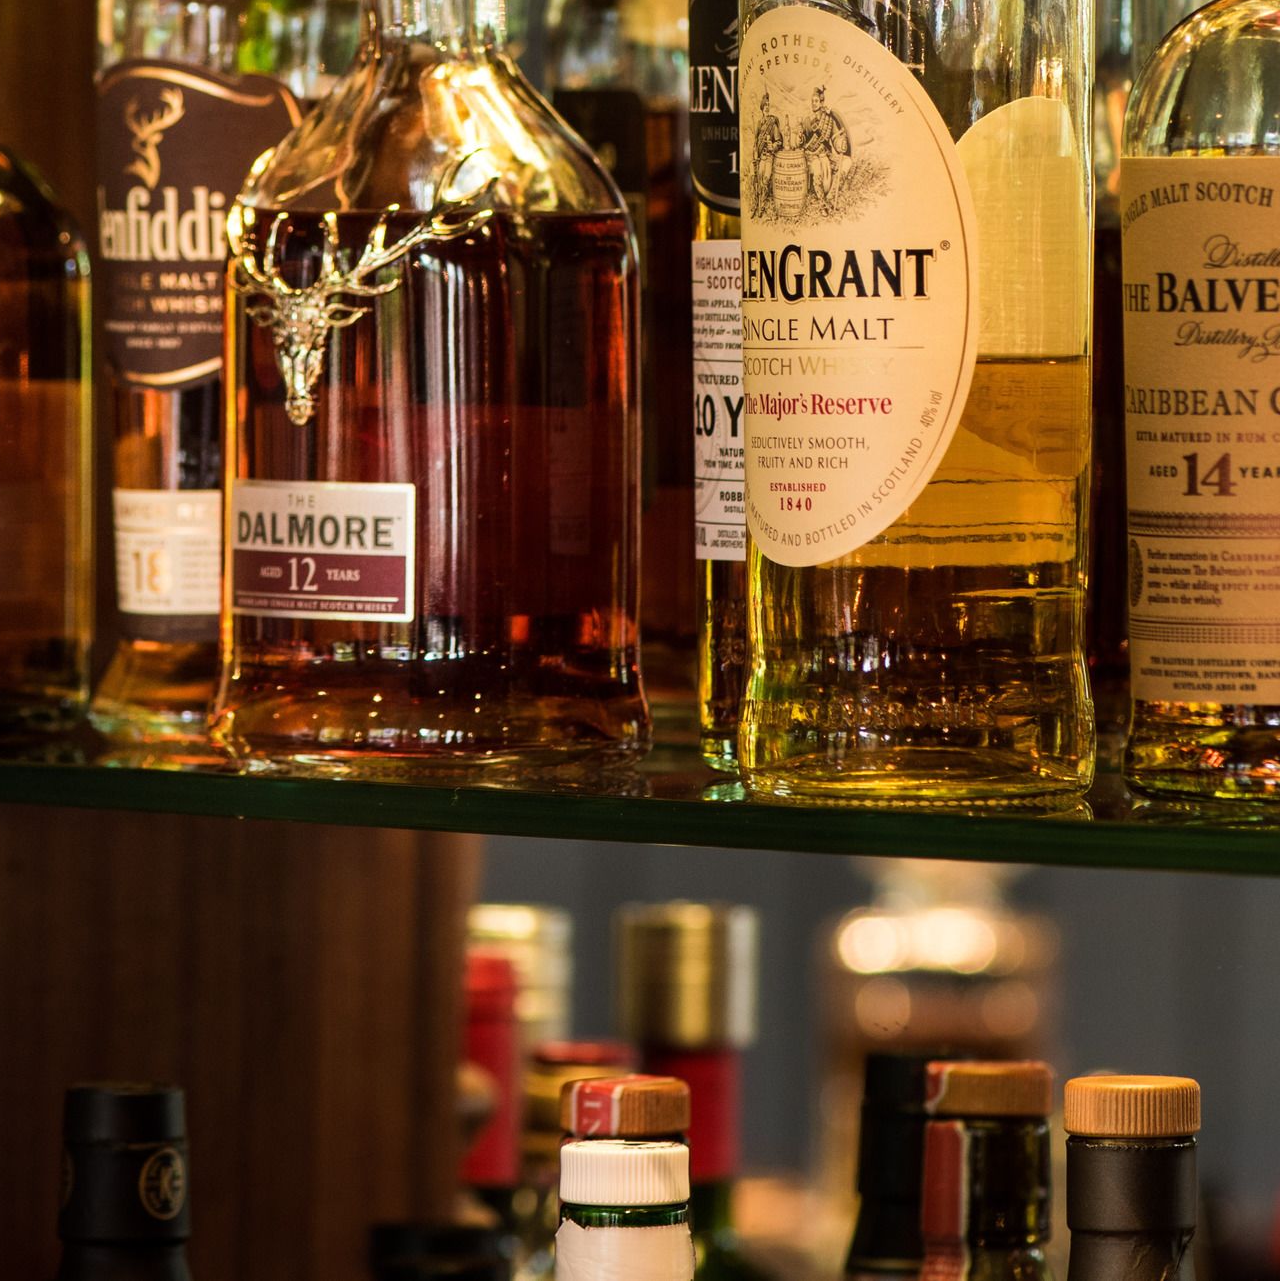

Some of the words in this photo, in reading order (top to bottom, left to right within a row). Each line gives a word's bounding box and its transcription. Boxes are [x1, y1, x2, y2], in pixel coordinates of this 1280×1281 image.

[760, 33, 830, 55] ROTHES
[843, 54, 906, 116] DISTILLERY
[786, 161, 806, 169] GRANT
[773, 178, 806, 187] GLENGRANT
[775, 185, 804, 194] DISTILLERY
[1150, 182, 1190, 209] MALT
[1195, 181, 1274, 208] SCOTCH
[695, 257, 741, 271] HIGHLAND
[159, 272, 218, 290] MALT
[711, 298, 737, 310] APPLES,
[1123, 283, 1150, 312] THE
[742, 315, 799, 342] SINGLE
[810, 315, 895, 341] MALT
[743, 356, 792, 376] SCOTCH
[698, 373, 739, 386] NURTURED
[744, 392, 758, 415] The
[759, 391, 808, 421] Major's
[810, 393, 893, 415] Reserve
[695, 393, 716, 437] 10
[751, 436, 804, 450] SEDUCTIVELY
[808, 436, 870, 452] SMOOTH,
[1161, 430, 1212, 443] MATURED
[1216, 432, 1231, 443] IN
[1236, 432, 1267, 443] RUM
[718, 459, 733, 469] TIME
[751, 503, 779, 542] MATURED
[781, 533, 802, 547] AND
[805, 514, 857, 546] BOTTLED
[857, 501, 873, 519] IN
[872, 437, 923, 504] SCOTLAND
[919, 405, 938, 429] 40%
[930, 390, 943, 405] vol
[757, 456, 785, 469] FRUITY
[788, 456, 813, 469] AND
[818, 456, 848, 469] RICH
[1149, 465, 1178, 478] AGED
[1182, 451, 1238, 497] 14
[770, 482, 826, 492] ESTABLISHED
[288, 493, 316, 508] THE
[779, 497, 812, 512] 1840
[237, 509, 394, 549] DALMORE
[1221, 550, 1280, 563] CARIBBEAN
[130, 550, 169, 594] 18
[260, 566, 282, 579] AGED
[288, 556, 318, 592] 12
[326, 568, 360, 582] YEARS
[1221, 582, 1250, 592] SPICY
[270, 598, 295, 610] SINGLE
[296, 599, 318, 611] MALT
[319, 600, 355, 613] SCOTCH
[355, 601, 394, 614] WHISKY
